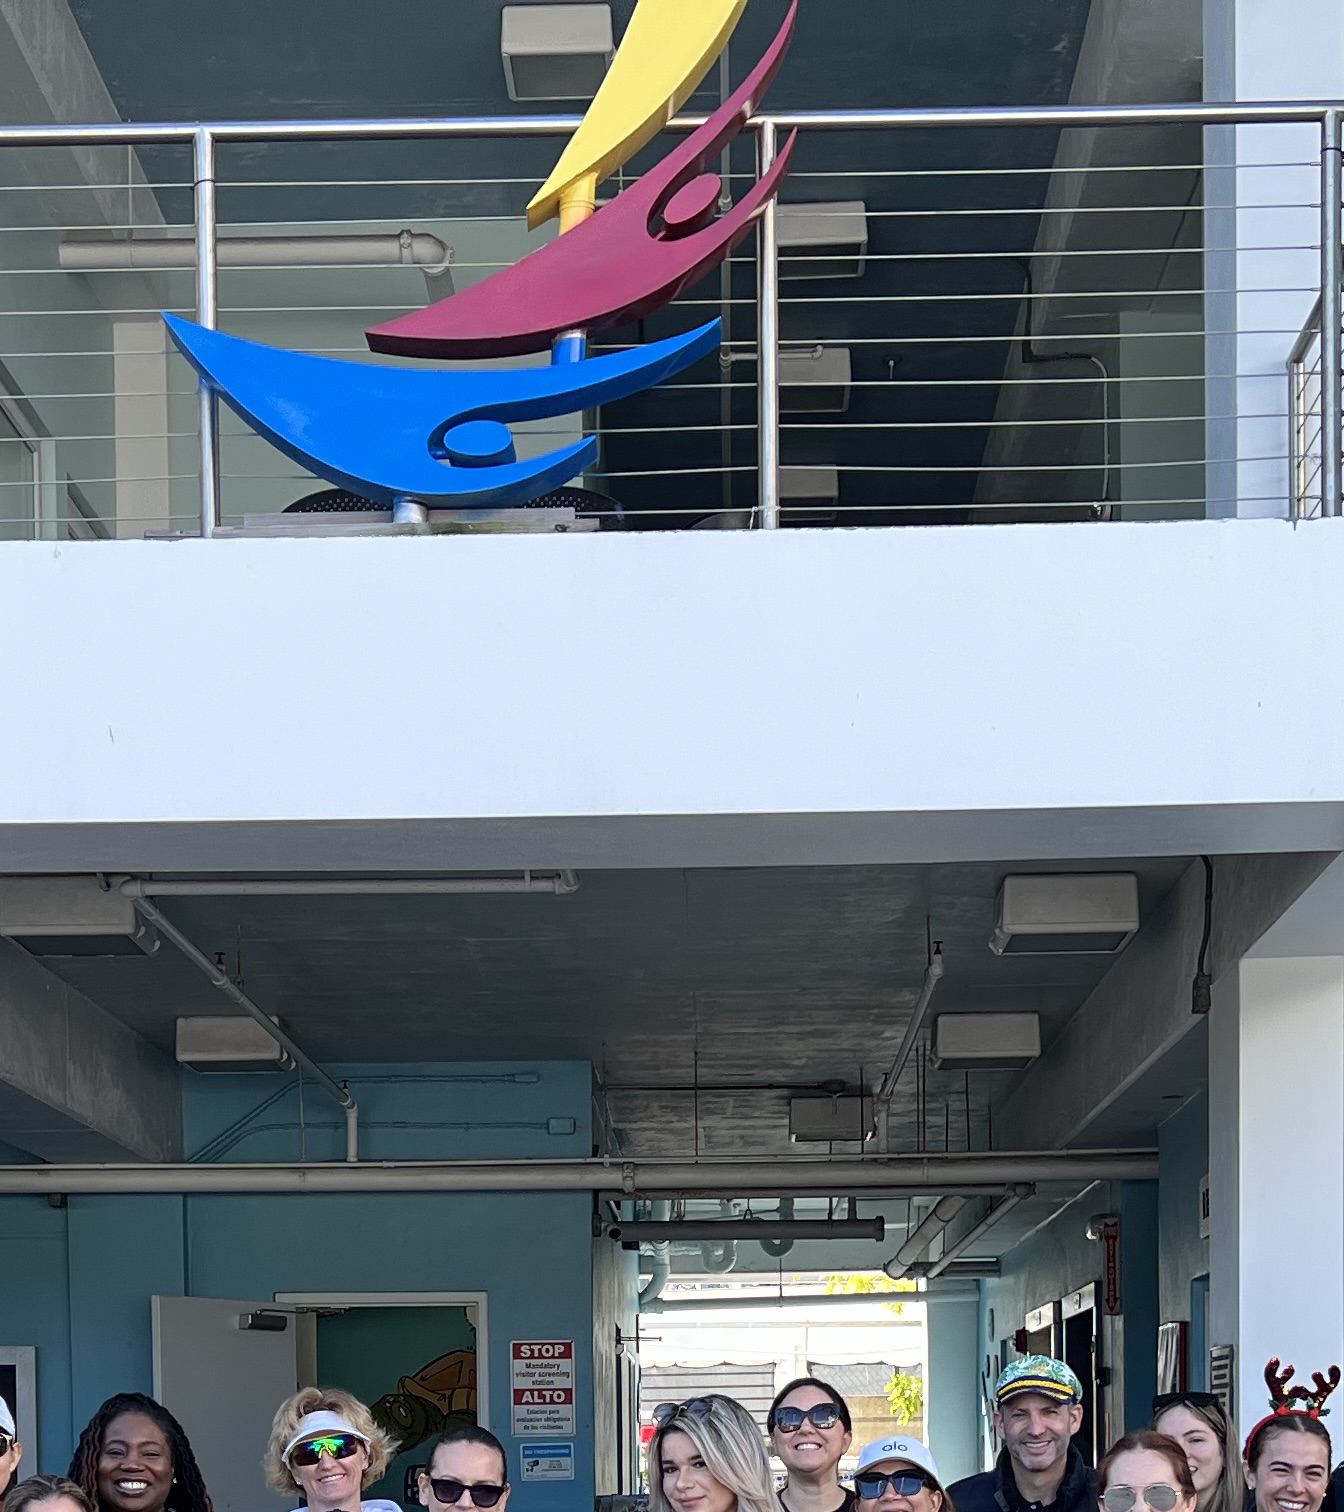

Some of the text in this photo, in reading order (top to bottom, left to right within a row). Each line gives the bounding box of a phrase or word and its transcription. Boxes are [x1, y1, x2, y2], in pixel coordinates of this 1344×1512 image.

[520, 1345, 565, 1357] STOP
[525, 1362, 560, 1370] Mandatory
[538, 1371, 570, 1379] screening
[521, 1390, 566, 1403] ALTO
[882, 1441, 908, 1451] alo
